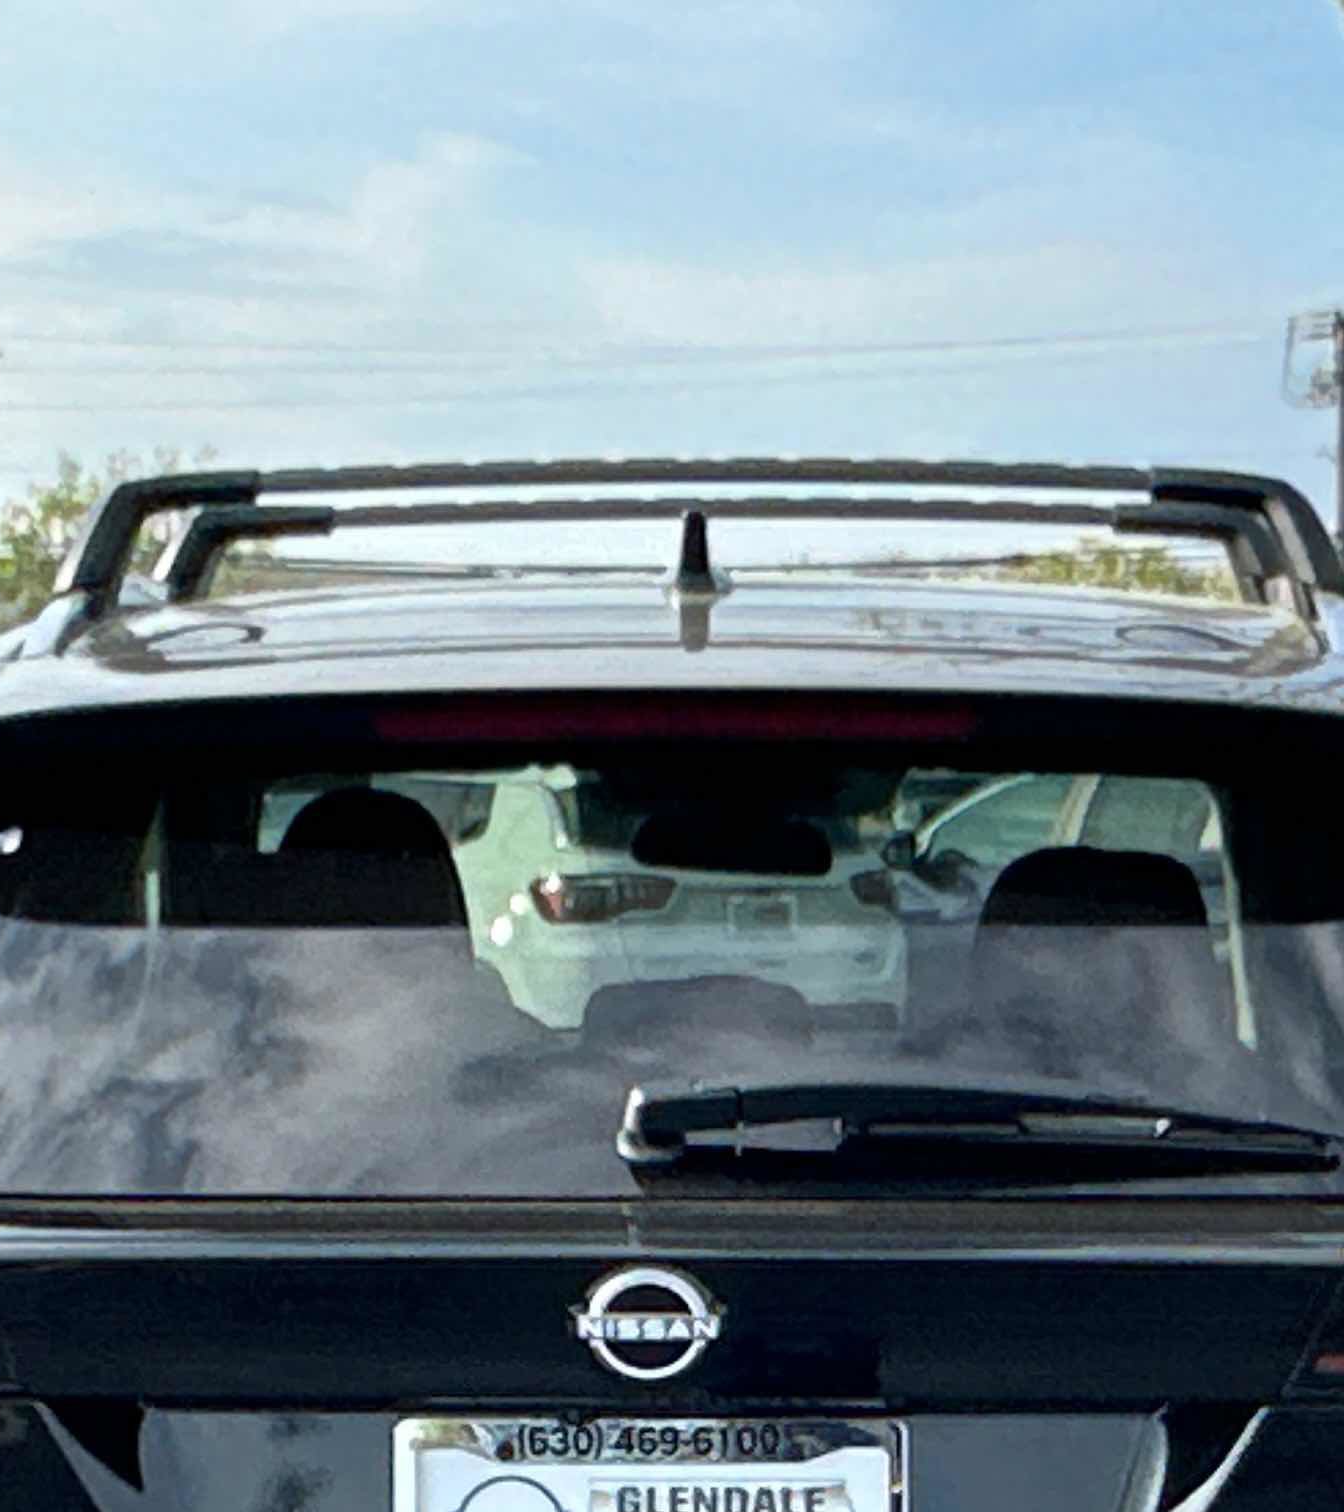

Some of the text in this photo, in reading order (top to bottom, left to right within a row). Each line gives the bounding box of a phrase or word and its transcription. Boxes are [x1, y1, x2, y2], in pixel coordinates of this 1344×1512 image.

[577, 1316, 720, 1341] NISSAN
[518, 1423, 779, 1461] (630) 469-6100
